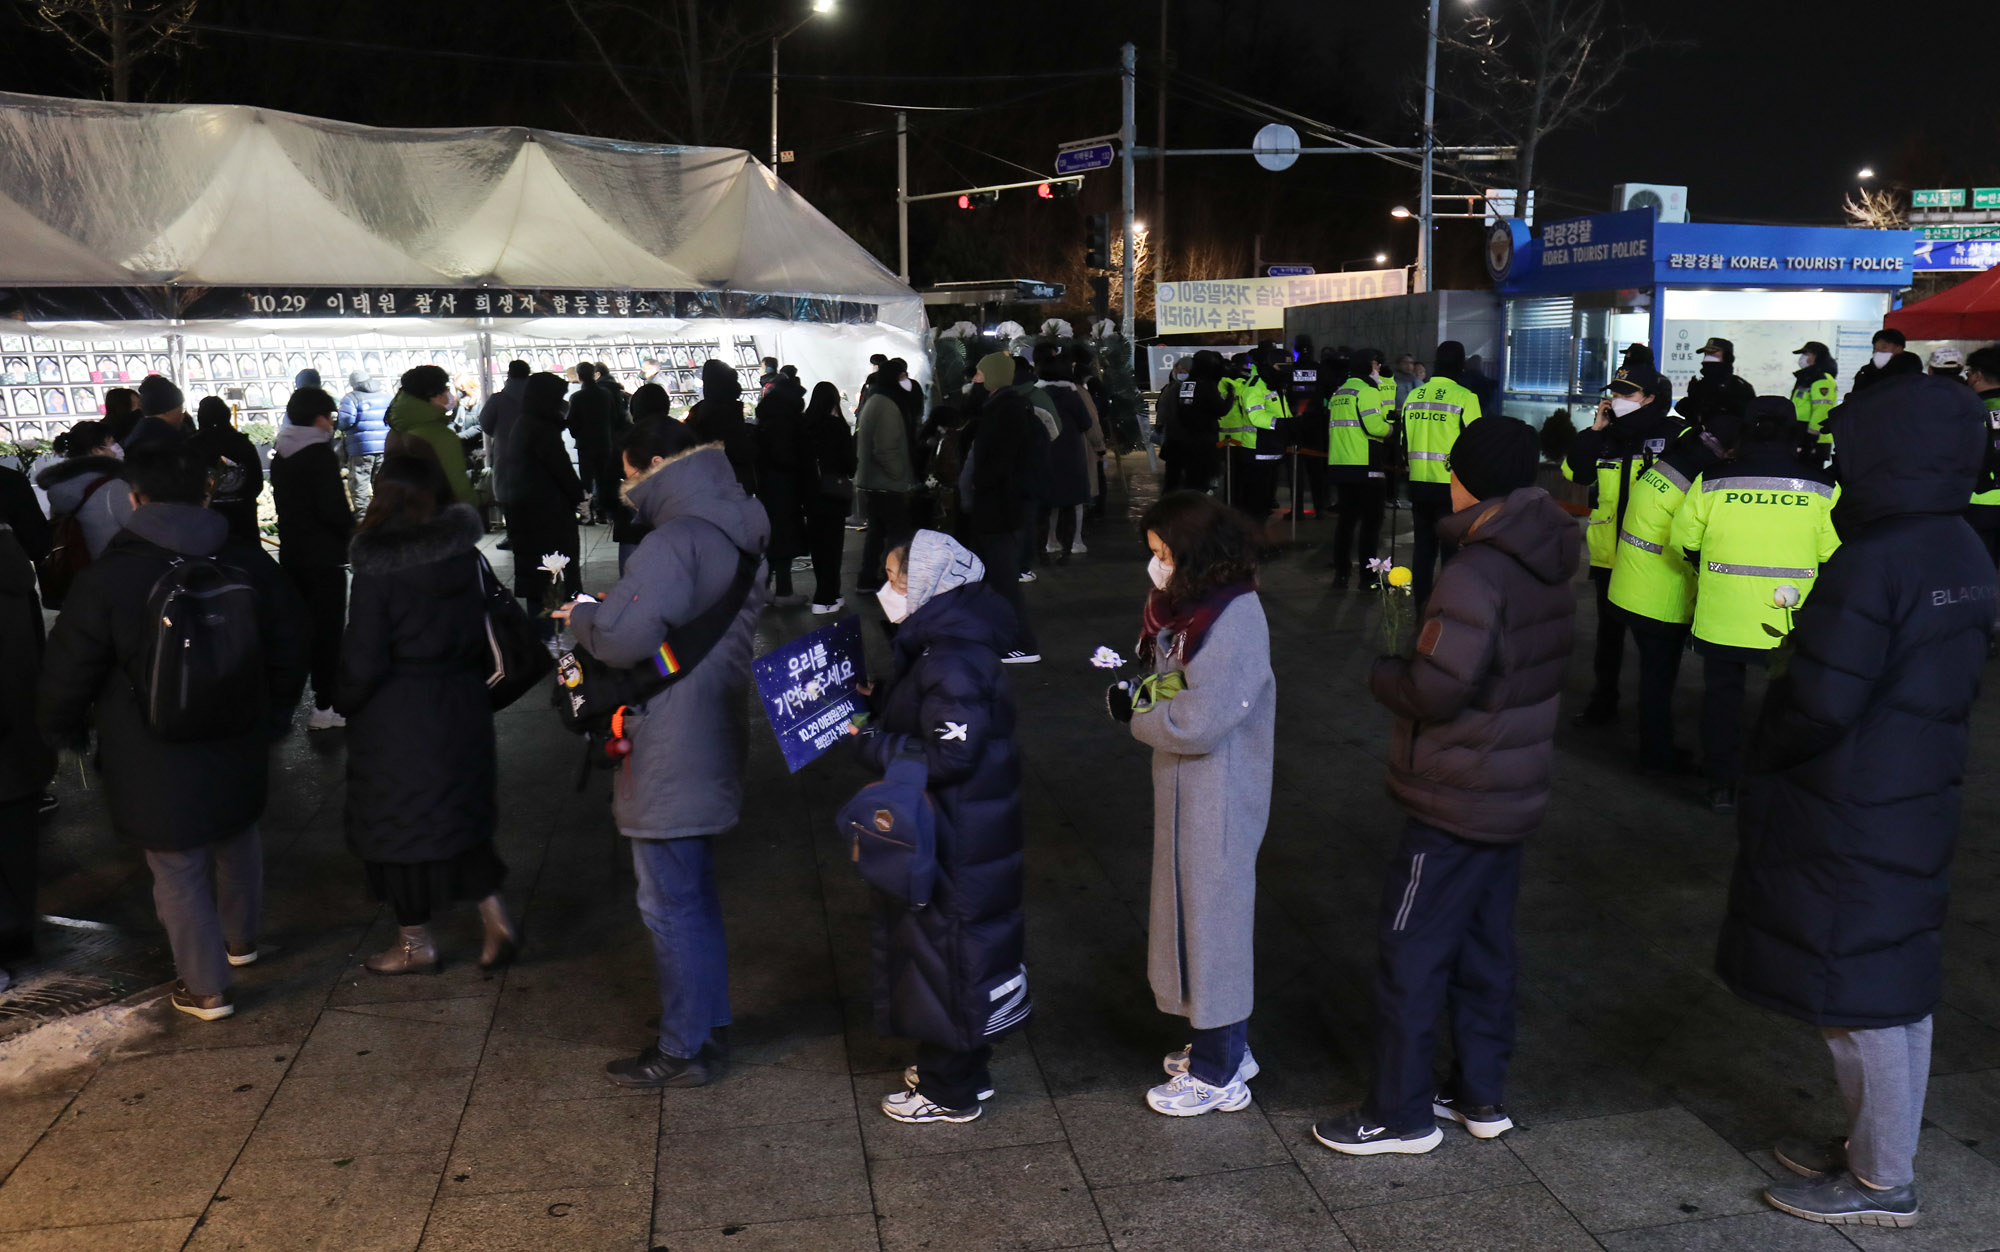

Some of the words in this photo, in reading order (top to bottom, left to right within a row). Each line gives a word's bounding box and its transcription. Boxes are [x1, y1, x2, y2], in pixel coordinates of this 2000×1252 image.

[1543, 220, 1592, 248] 관광경찰
[1543, 249, 1569, 266] KOREA
[1573, 244, 1609, 263] TOURIST
[1612, 240, 1647, 258] POLICE
[1670, 253, 1724, 269] 관광경찰
[1731, 256, 1779, 269] KOREA
[1787, 257, 1846, 270] TOURIST
[1853, 257, 1903, 270] POLICE
[251, 294, 306, 313] 10.29
[327, 293, 396, 314] 이태원
[415, 293, 457, 314] 참사
[475, 293, 536, 314] 희생자
[552, 295, 651, 314] 합동분향소
[1409, 412, 1447, 422] POLICE
[1643, 471, 1670, 493] OLICE
[1725, 493, 1809, 506] POLICE
[788, 643, 828, 681] 우리를
[799, 721, 820, 742] 10.29
